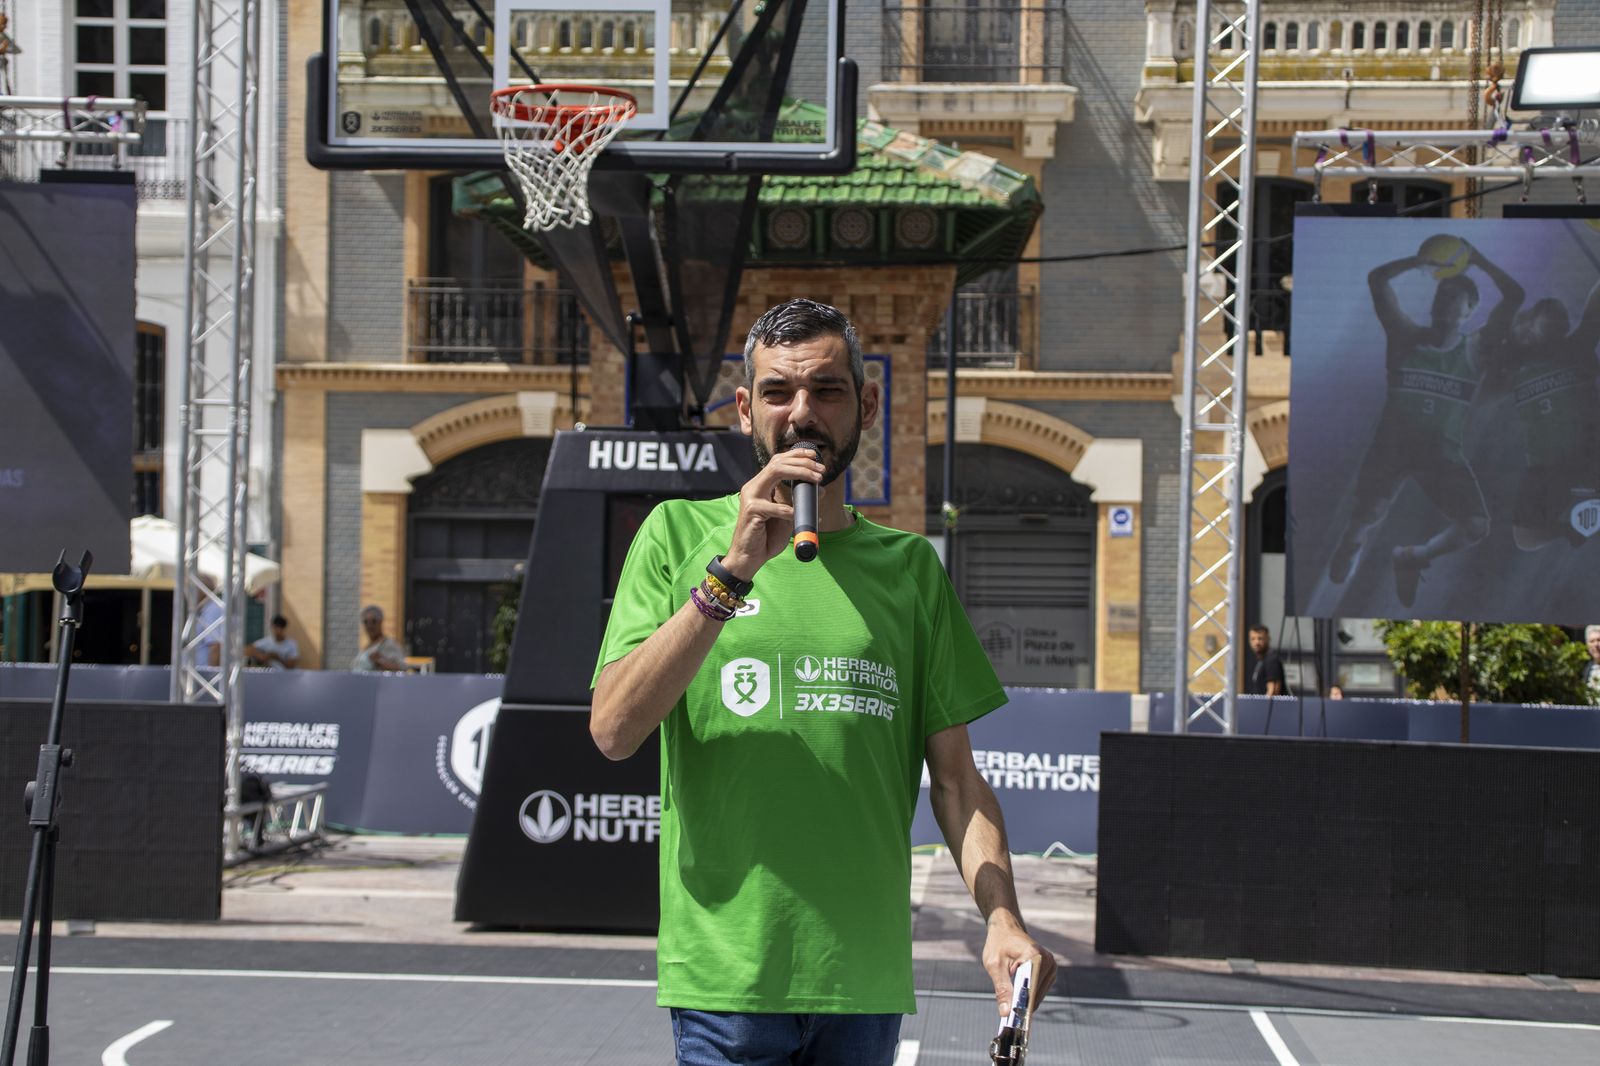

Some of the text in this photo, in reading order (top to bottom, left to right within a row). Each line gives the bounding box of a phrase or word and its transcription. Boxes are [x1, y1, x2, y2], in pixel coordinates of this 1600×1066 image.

[588, 440, 718, 472] HUELVA
[244, 722, 340, 735] HERBALIFE
[243, 734, 339, 748] NUTRITION
[971, 750, 1100, 773] ERBALIFE
[981, 769, 1100, 792] TRITION
[574, 793, 660, 818] HERB
